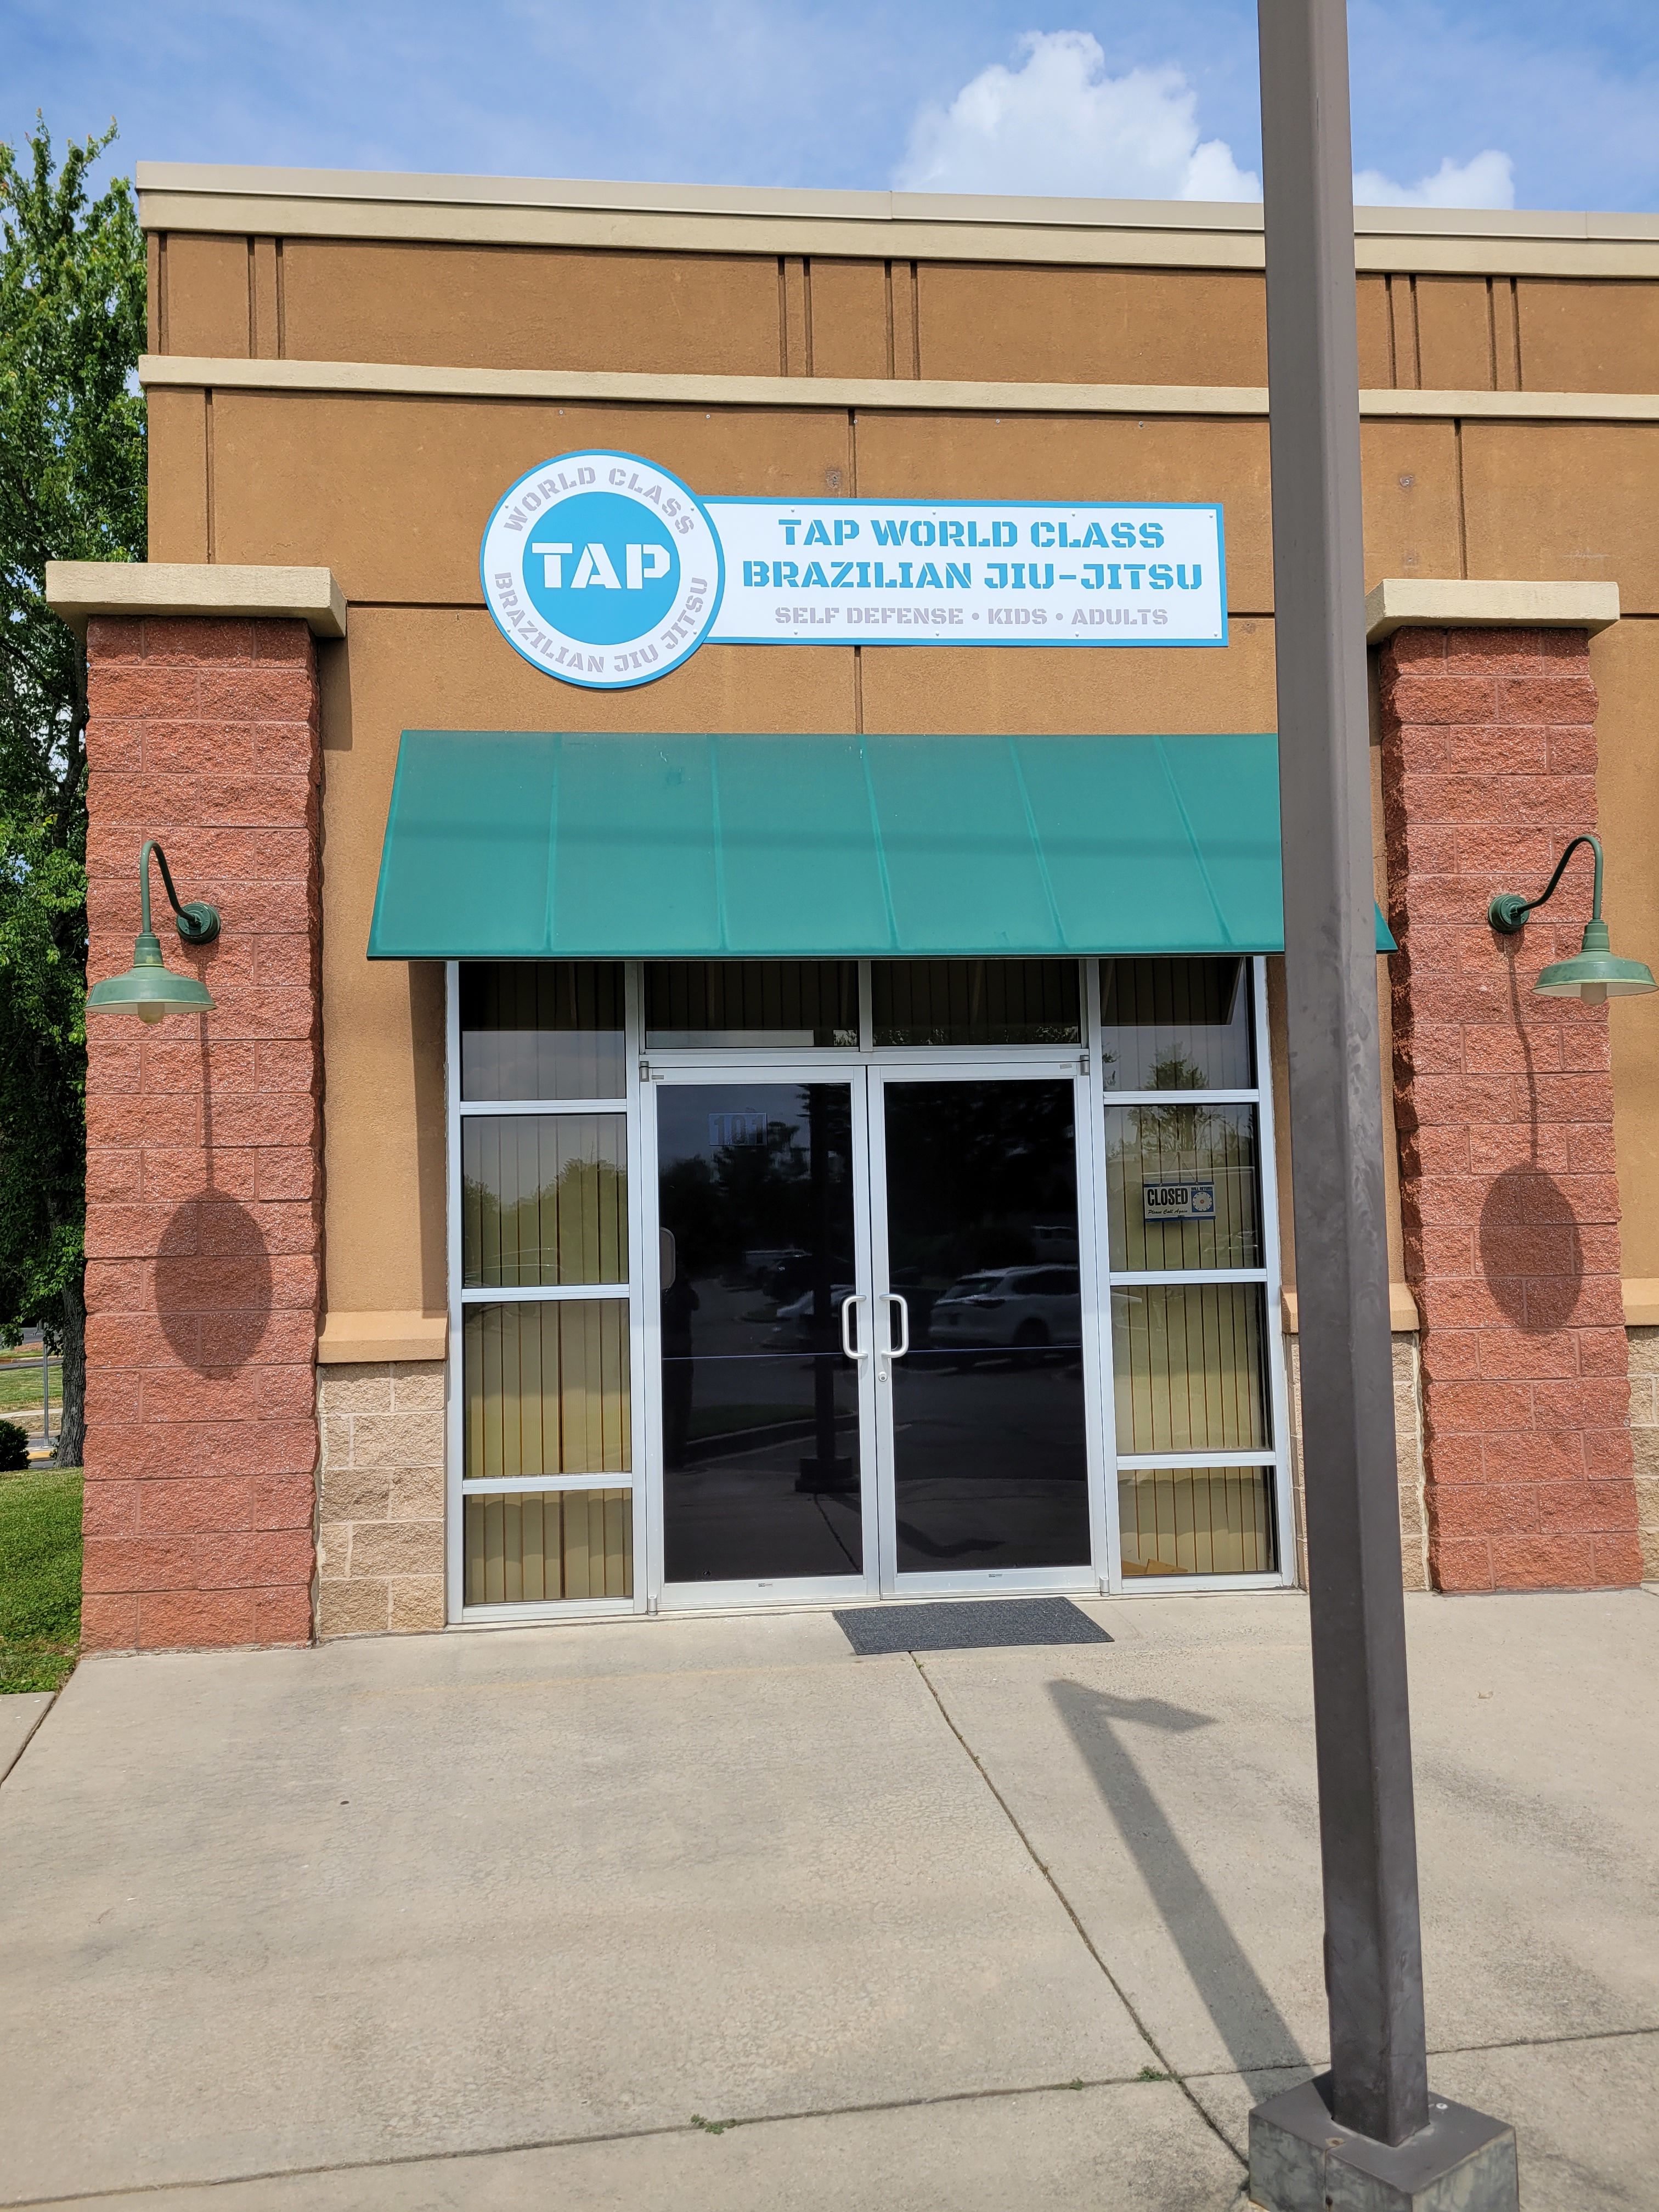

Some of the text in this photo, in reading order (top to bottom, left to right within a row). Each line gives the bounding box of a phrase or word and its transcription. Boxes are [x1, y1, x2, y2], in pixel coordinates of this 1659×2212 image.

[504, 467, 695, 534] WORLD CLASS
[778, 520, 1164, 548] TAP WORLD CLASS
[532, 542, 670, 589] TAP
[743, 561, 1202, 590] BRAZILIAN JIU-JITSU
[494, 572, 708, 673] BRAZILIAN JIU JITSU
[775, 607, 1168, 625] SELF DEFENSE KIDS ADULTS
[714, 1114, 763, 1144] 101
[1147, 1188, 1188, 1206] CLOSED
